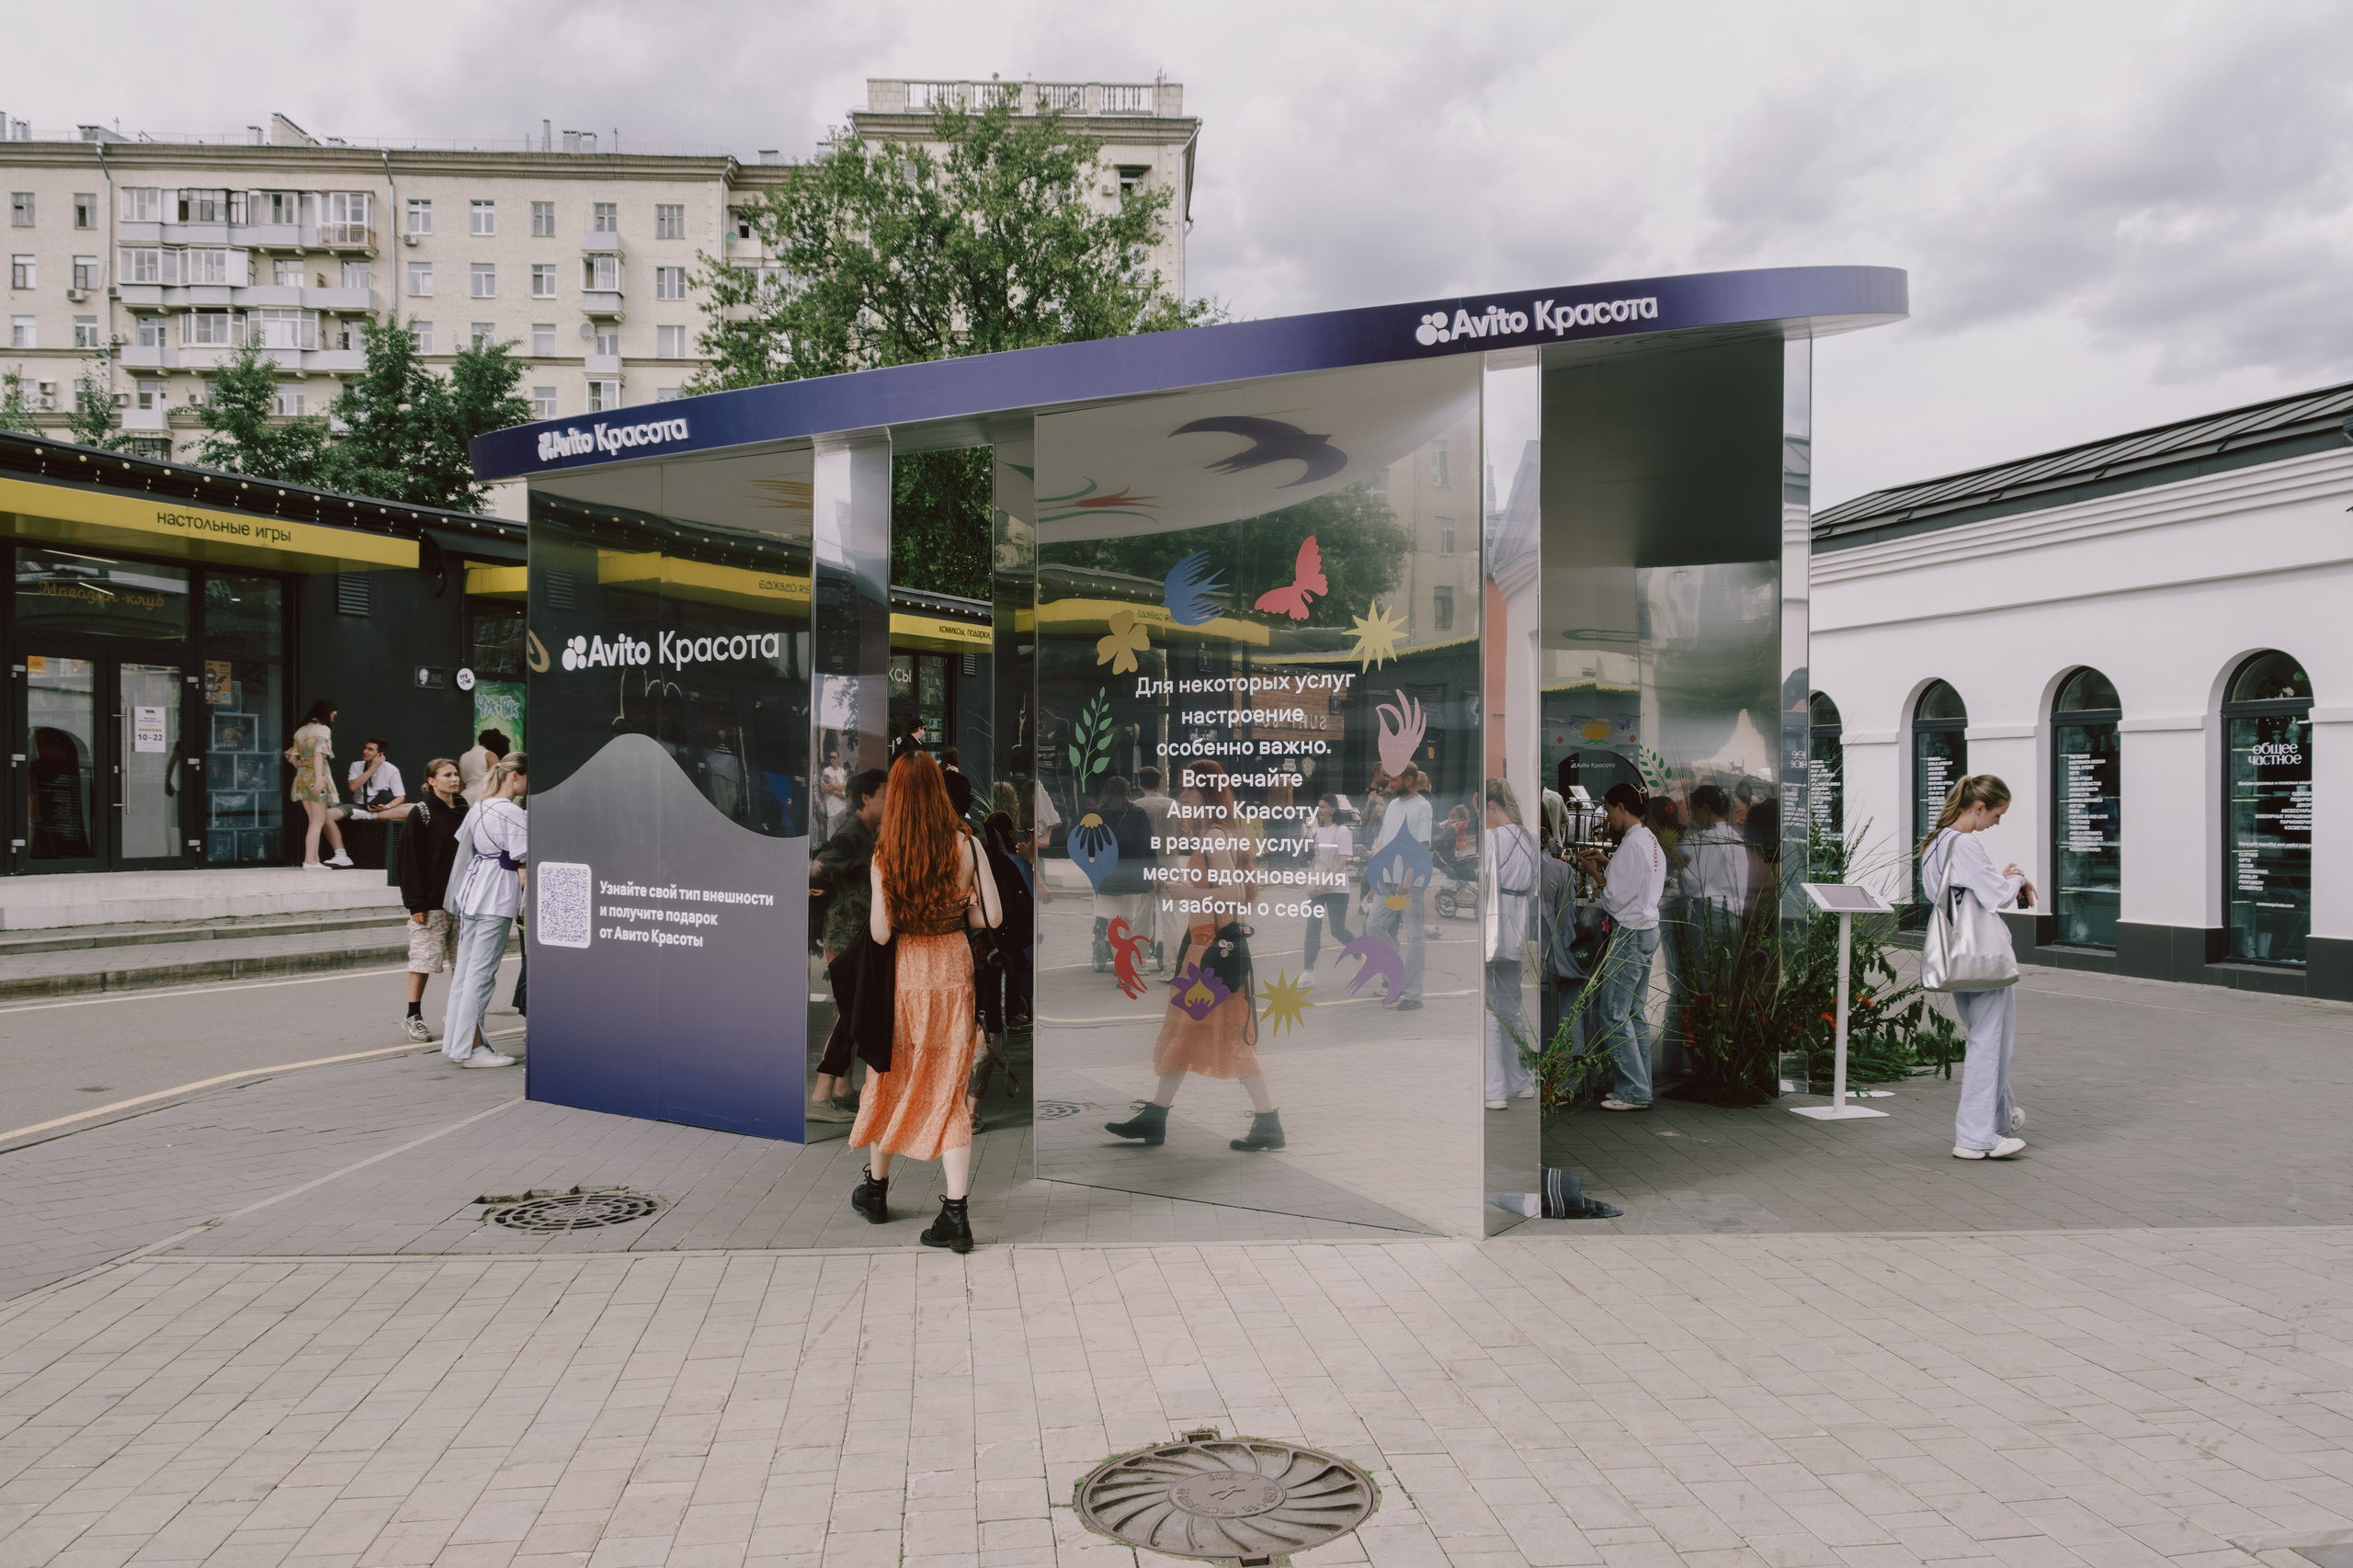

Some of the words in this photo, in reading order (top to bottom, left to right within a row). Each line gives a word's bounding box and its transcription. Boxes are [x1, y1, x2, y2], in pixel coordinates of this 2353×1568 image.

[1450, 305, 1529, 341] Avito
[1533, 297, 1658, 336] Красота
[553, 427, 595, 458] Avito
[594, 418, 689, 456] Красота
[157, 512, 250, 536] настольные
[256, 526, 291, 543] игры
[939, 625, 966, 638] комиксы,
[587, 633, 651, 667] Avito
[659, 631, 779, 671] Красота
[1135, 676, 1174, 699] Для
[1179, 676, 1290, 696] некоторых
[1294, 673, 1356, 695] услуг
[1181, 707, 1305, 728] настроение
[1156, 738, 1254, 756] особенно
[1259, 740, 1332, 755] важно.
[2252, 742, 2299, 756] общее
[2248, 754, 2302, 766] частное
[1182, 767, 1303, 791] Встречайте
[1166, 801, 1228, 819] Авито
[1233, 801, 1320, 824] Красоту
[1150, 836, 1162, 850] в
[1166, 836, 1251, 854] разделе
[1256, 837, 1314, 857] услуг
[1142, 867, 1202, 881] место
[1207, 869, 1347, 887] вдохновения
[599, 881, 647, 897] Узнайте
[649, 883, 677, 899] свой
[679, 889, 701, 901] тип
[703, 890, 774, 906] внешности
[600, 906, 608, 916] и
[609, 907, 664, 922] получите
[665, 910, 719, 927] подарок
[1162, 898, 1174, 912] и
[1178, 896, 1252, 915] заботы
[1256, 902, 1269, 915] о
[1274, 899, 1325, 918] себе
[599, 928, 613, 939] от
[614, 926, 649, 942] Авито
[651, 929, 704, 947] Красоты
